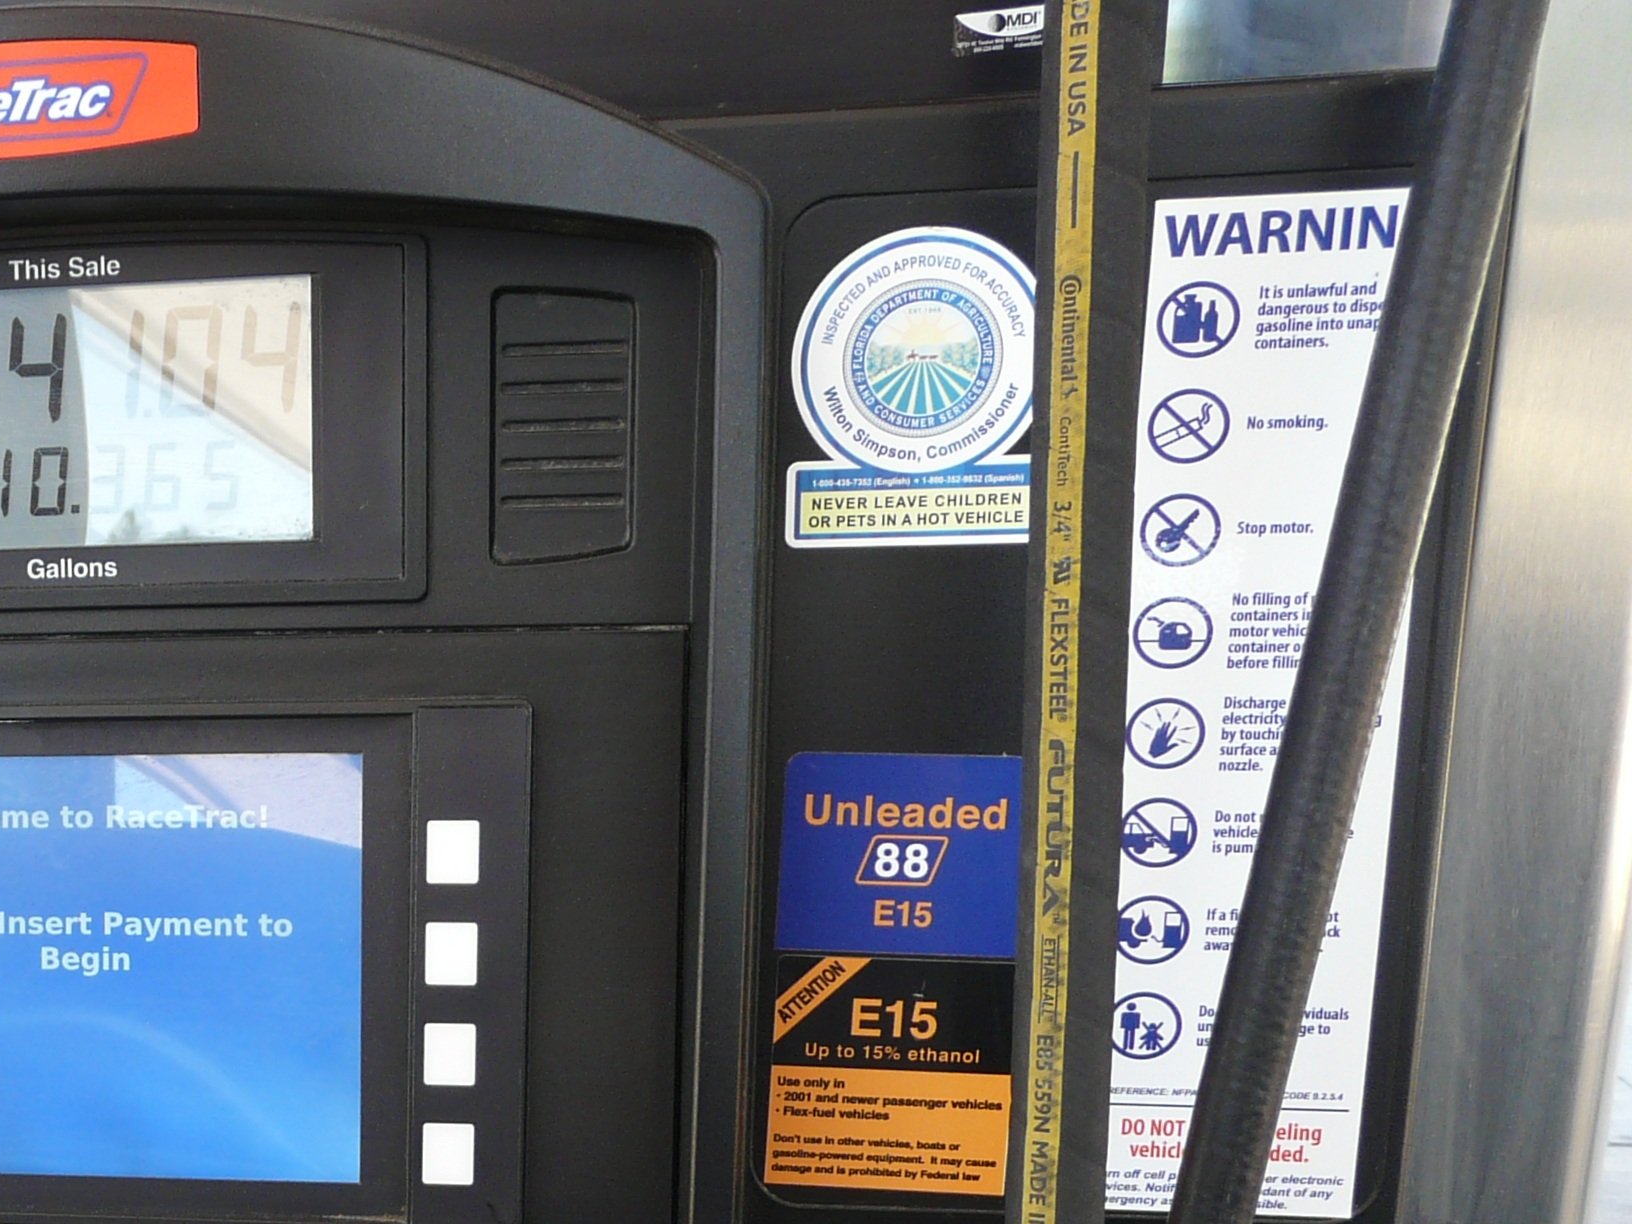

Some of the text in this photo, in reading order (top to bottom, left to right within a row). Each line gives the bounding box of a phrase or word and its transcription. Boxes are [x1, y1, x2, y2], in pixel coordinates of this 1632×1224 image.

[1006, 12, 1037, 26] MDI
[1165, 205, 1399, 258] WARNIN
[9, 256, 121, 281] This Sale
[821, 255, 1026, 345] INSPECTED AND APPROVED FOR ACCURACY
[823, 382, 1019, 463] Wilton Simpson, Commissioner
[1246, 416, 1329, 431] No smoking.
[811, 492, 1022, 511] NEVER LEAVE CHILDREN
[809, 510, 1024, 528] OR PETS IN A HOT VEHICLE
[1236, 522, 1314, 537] Stop motor.
[27, 559, 118, 580] Gallons
[61, 806, 94, 828] to
[106, 805, 270, 829] RaceTrac!
[804, 794, 1008, 830] Unleaded
[1040, 738, 1065, 918] FUTURA
[874, 843, 929, 878] 88
[103, 912, 247, 943] Payment
[259, 913, 293, 937] to
[874, 900, 933, 928] E15
[40, 946, 131, 975] Begin
[778, 960, 846, 1024] ATTENTION
[851, 998, 938, 1040] E15
[805, 1043, 980, 1063] Up to 15% ethanol
[1028, 1140, 1050, 1206] MADE
